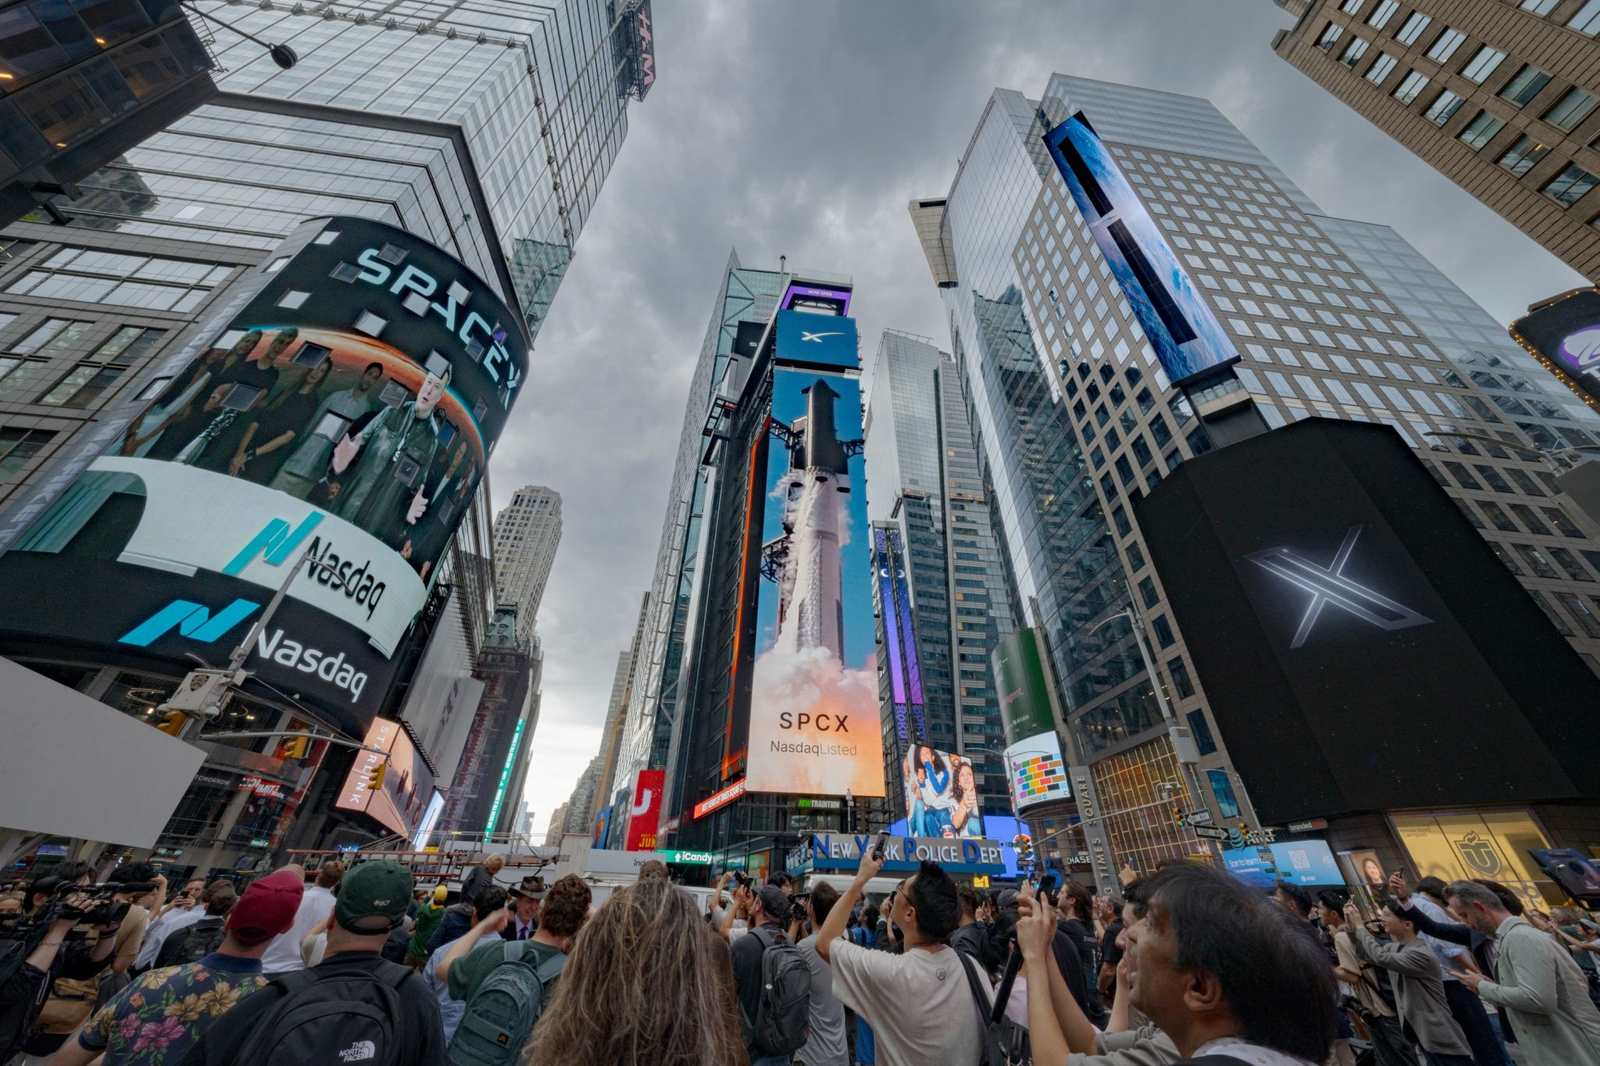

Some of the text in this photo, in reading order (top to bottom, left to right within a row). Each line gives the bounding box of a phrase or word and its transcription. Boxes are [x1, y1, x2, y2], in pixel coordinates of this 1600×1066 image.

[306, 536, 387, 622] Nasdaq
[1242, 523, 1436, 650] X
[241, 622, 368, 703] Nasdaq
[779, 712, 849, 732] SPCX
[350, 725, 389, 804] STARLINK
[1077, 775, 1097, 827] SQUARE
[682, 851, 713, 863] iCandy
[813, 834, 853, 859] NEW
[903, 837, 959, 862] POLICE
[962, 839, 1005, 864] DEPT
[1067, 854, 1091, 865] CHASE
[1091, 837, 1110, 880] TIMES
[339, 1048, 363, 1056] NORTH
[343, 1054, 362, 1062] FACE
[352, 1041, 365, 1049] THE
